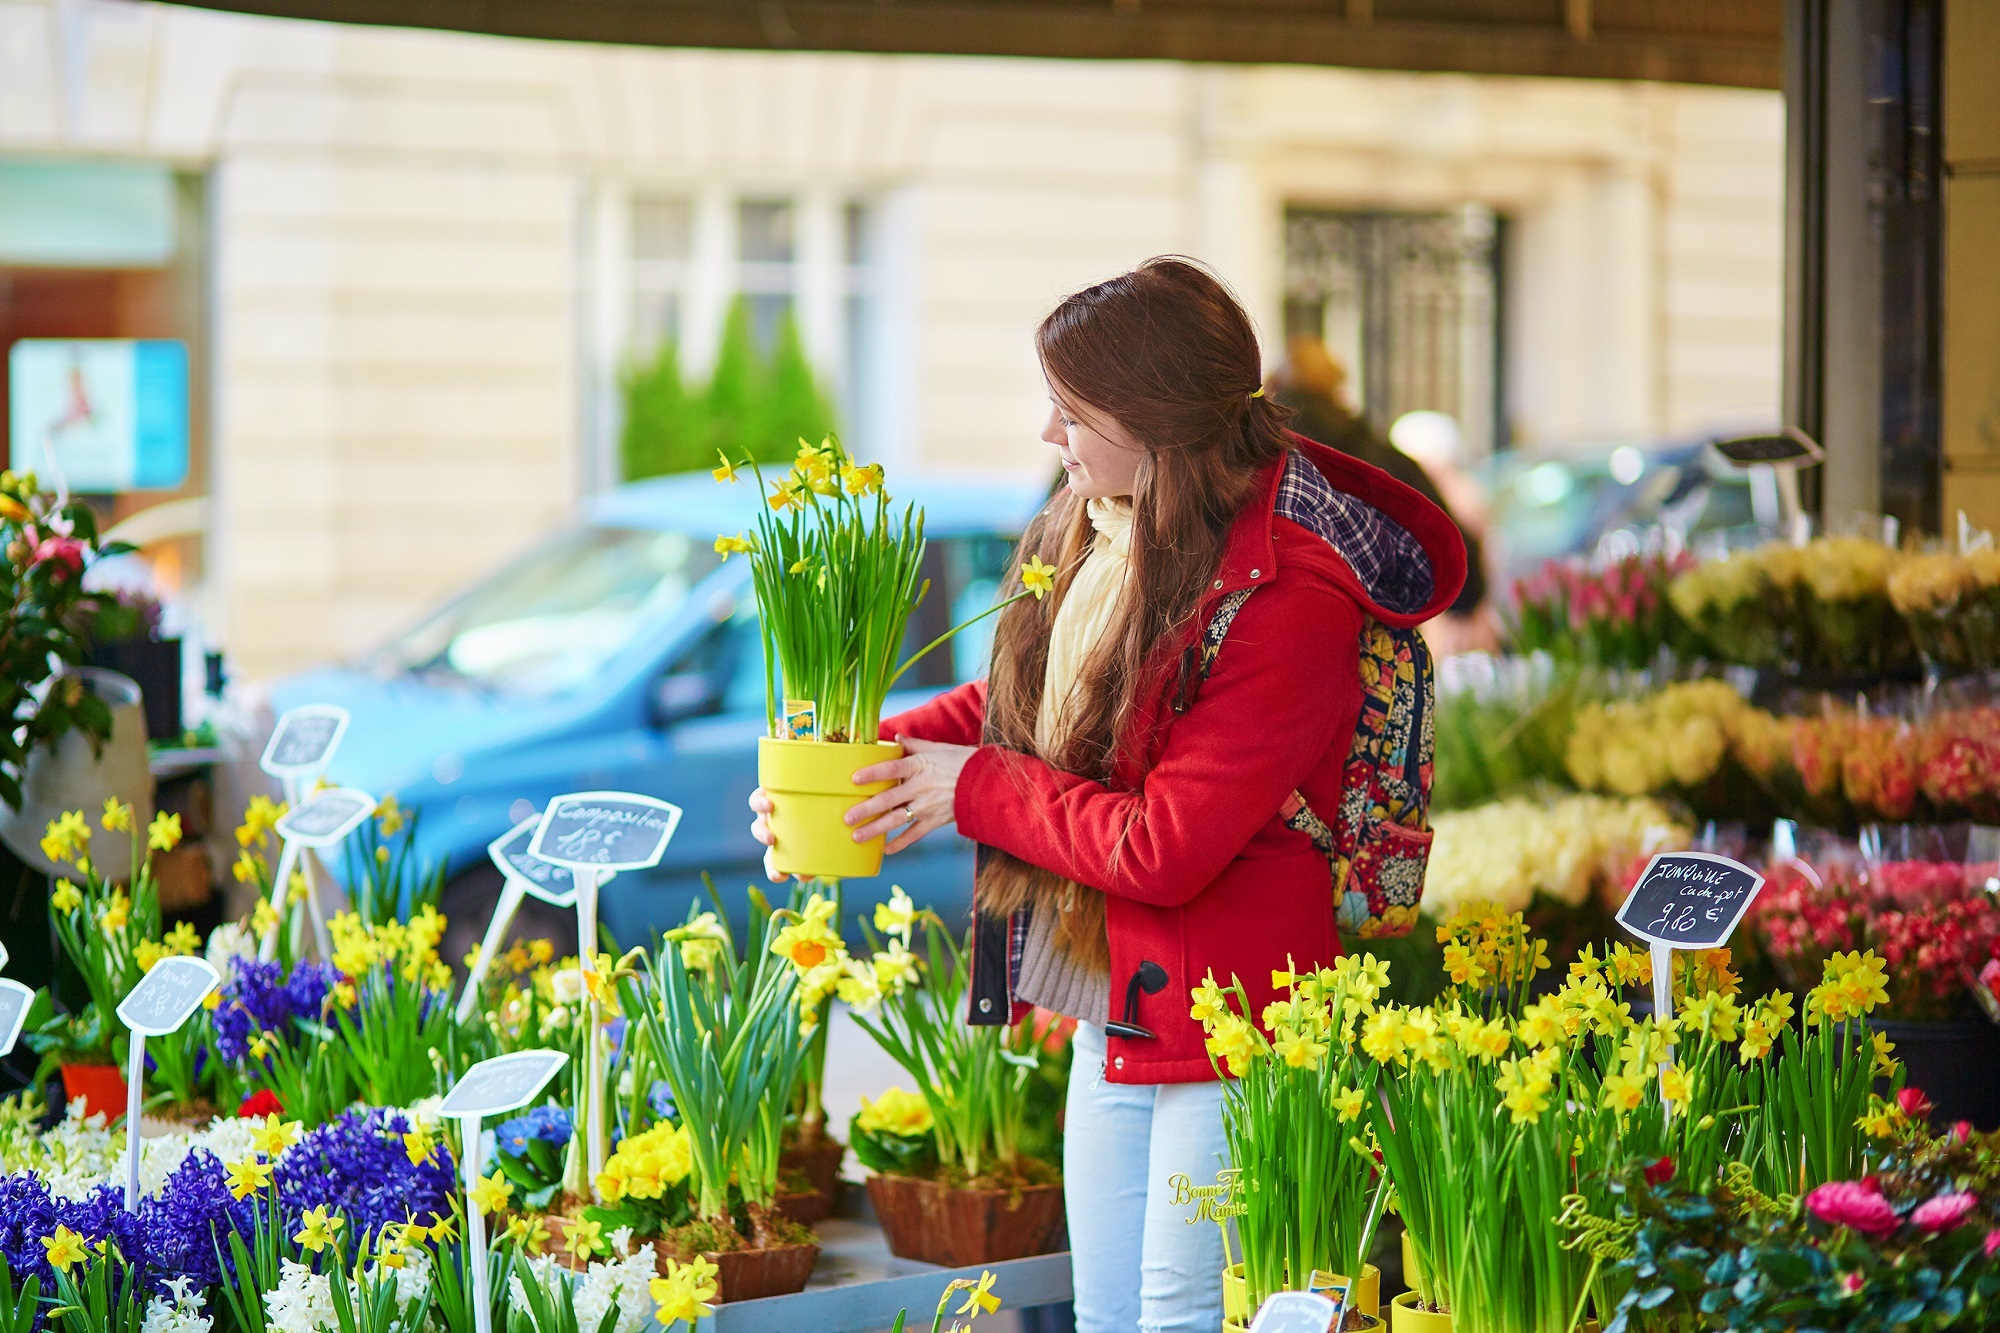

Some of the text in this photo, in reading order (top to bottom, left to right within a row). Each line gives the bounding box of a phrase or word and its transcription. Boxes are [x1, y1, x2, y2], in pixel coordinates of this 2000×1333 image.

[557, 801, 668, 830] Composition
[1168, 1171, 1223, 1206] Bonne
[1184, 1197, 1249, 1226] Mamie
[1550, 1193, 1626, 1235] Bonne
